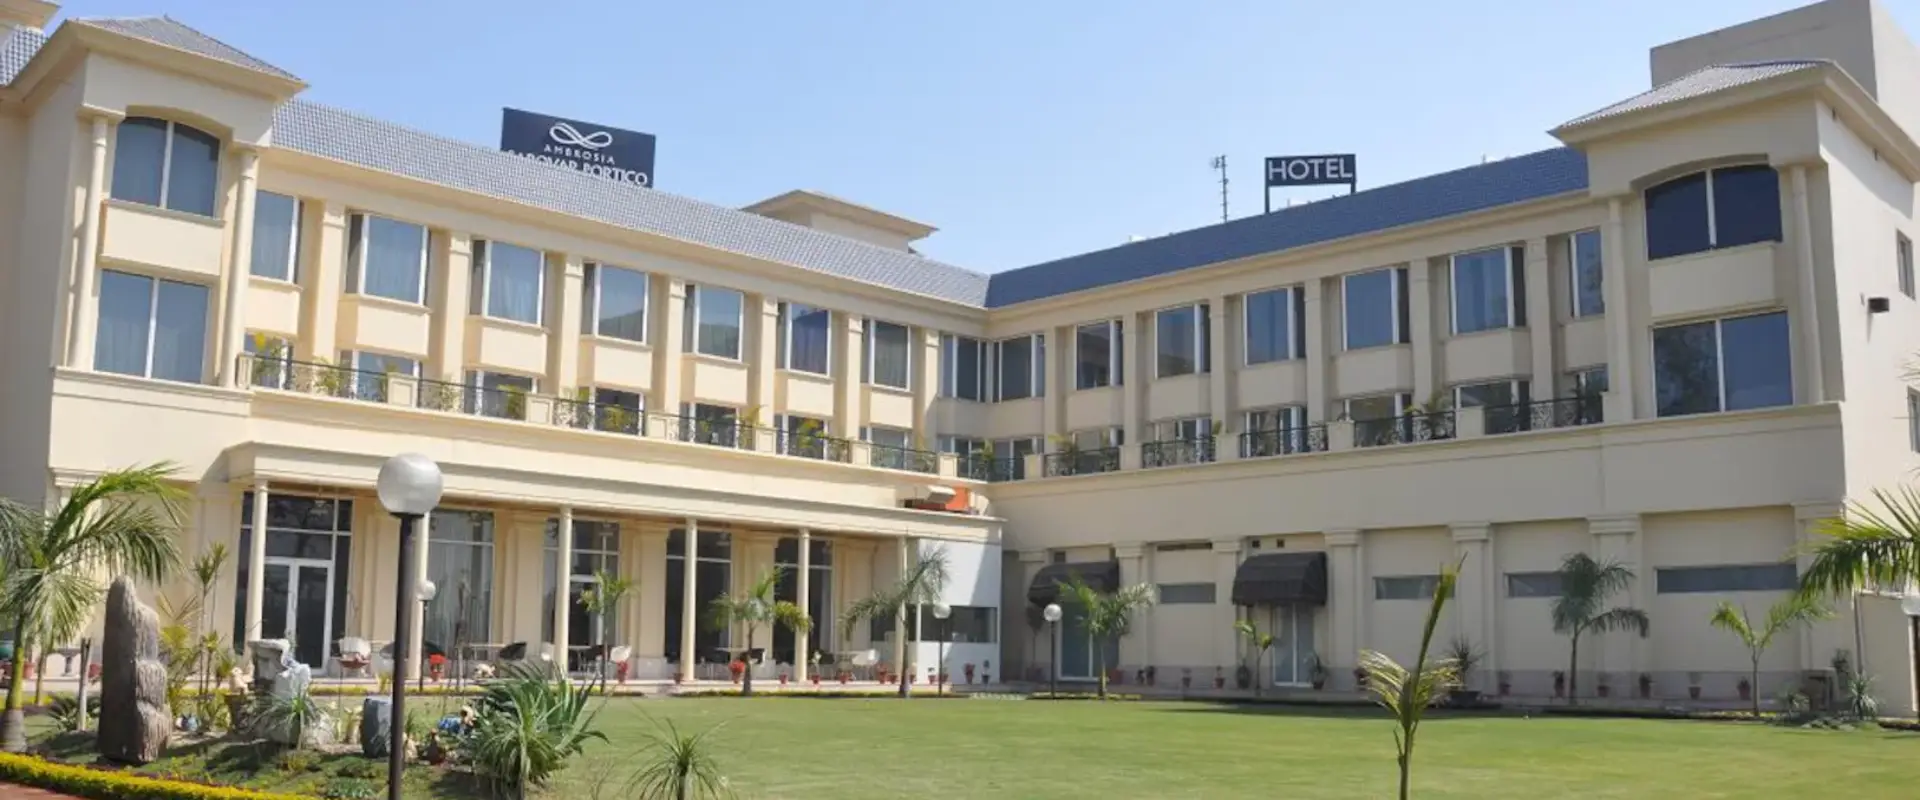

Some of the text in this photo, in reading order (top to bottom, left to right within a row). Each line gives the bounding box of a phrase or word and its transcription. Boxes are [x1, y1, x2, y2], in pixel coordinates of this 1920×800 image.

[543, 143, 615, 165] AMBROSIA
[583, 162, 648, 186] PORTICO
[1268, 157, 1353, 180] HOTEL
